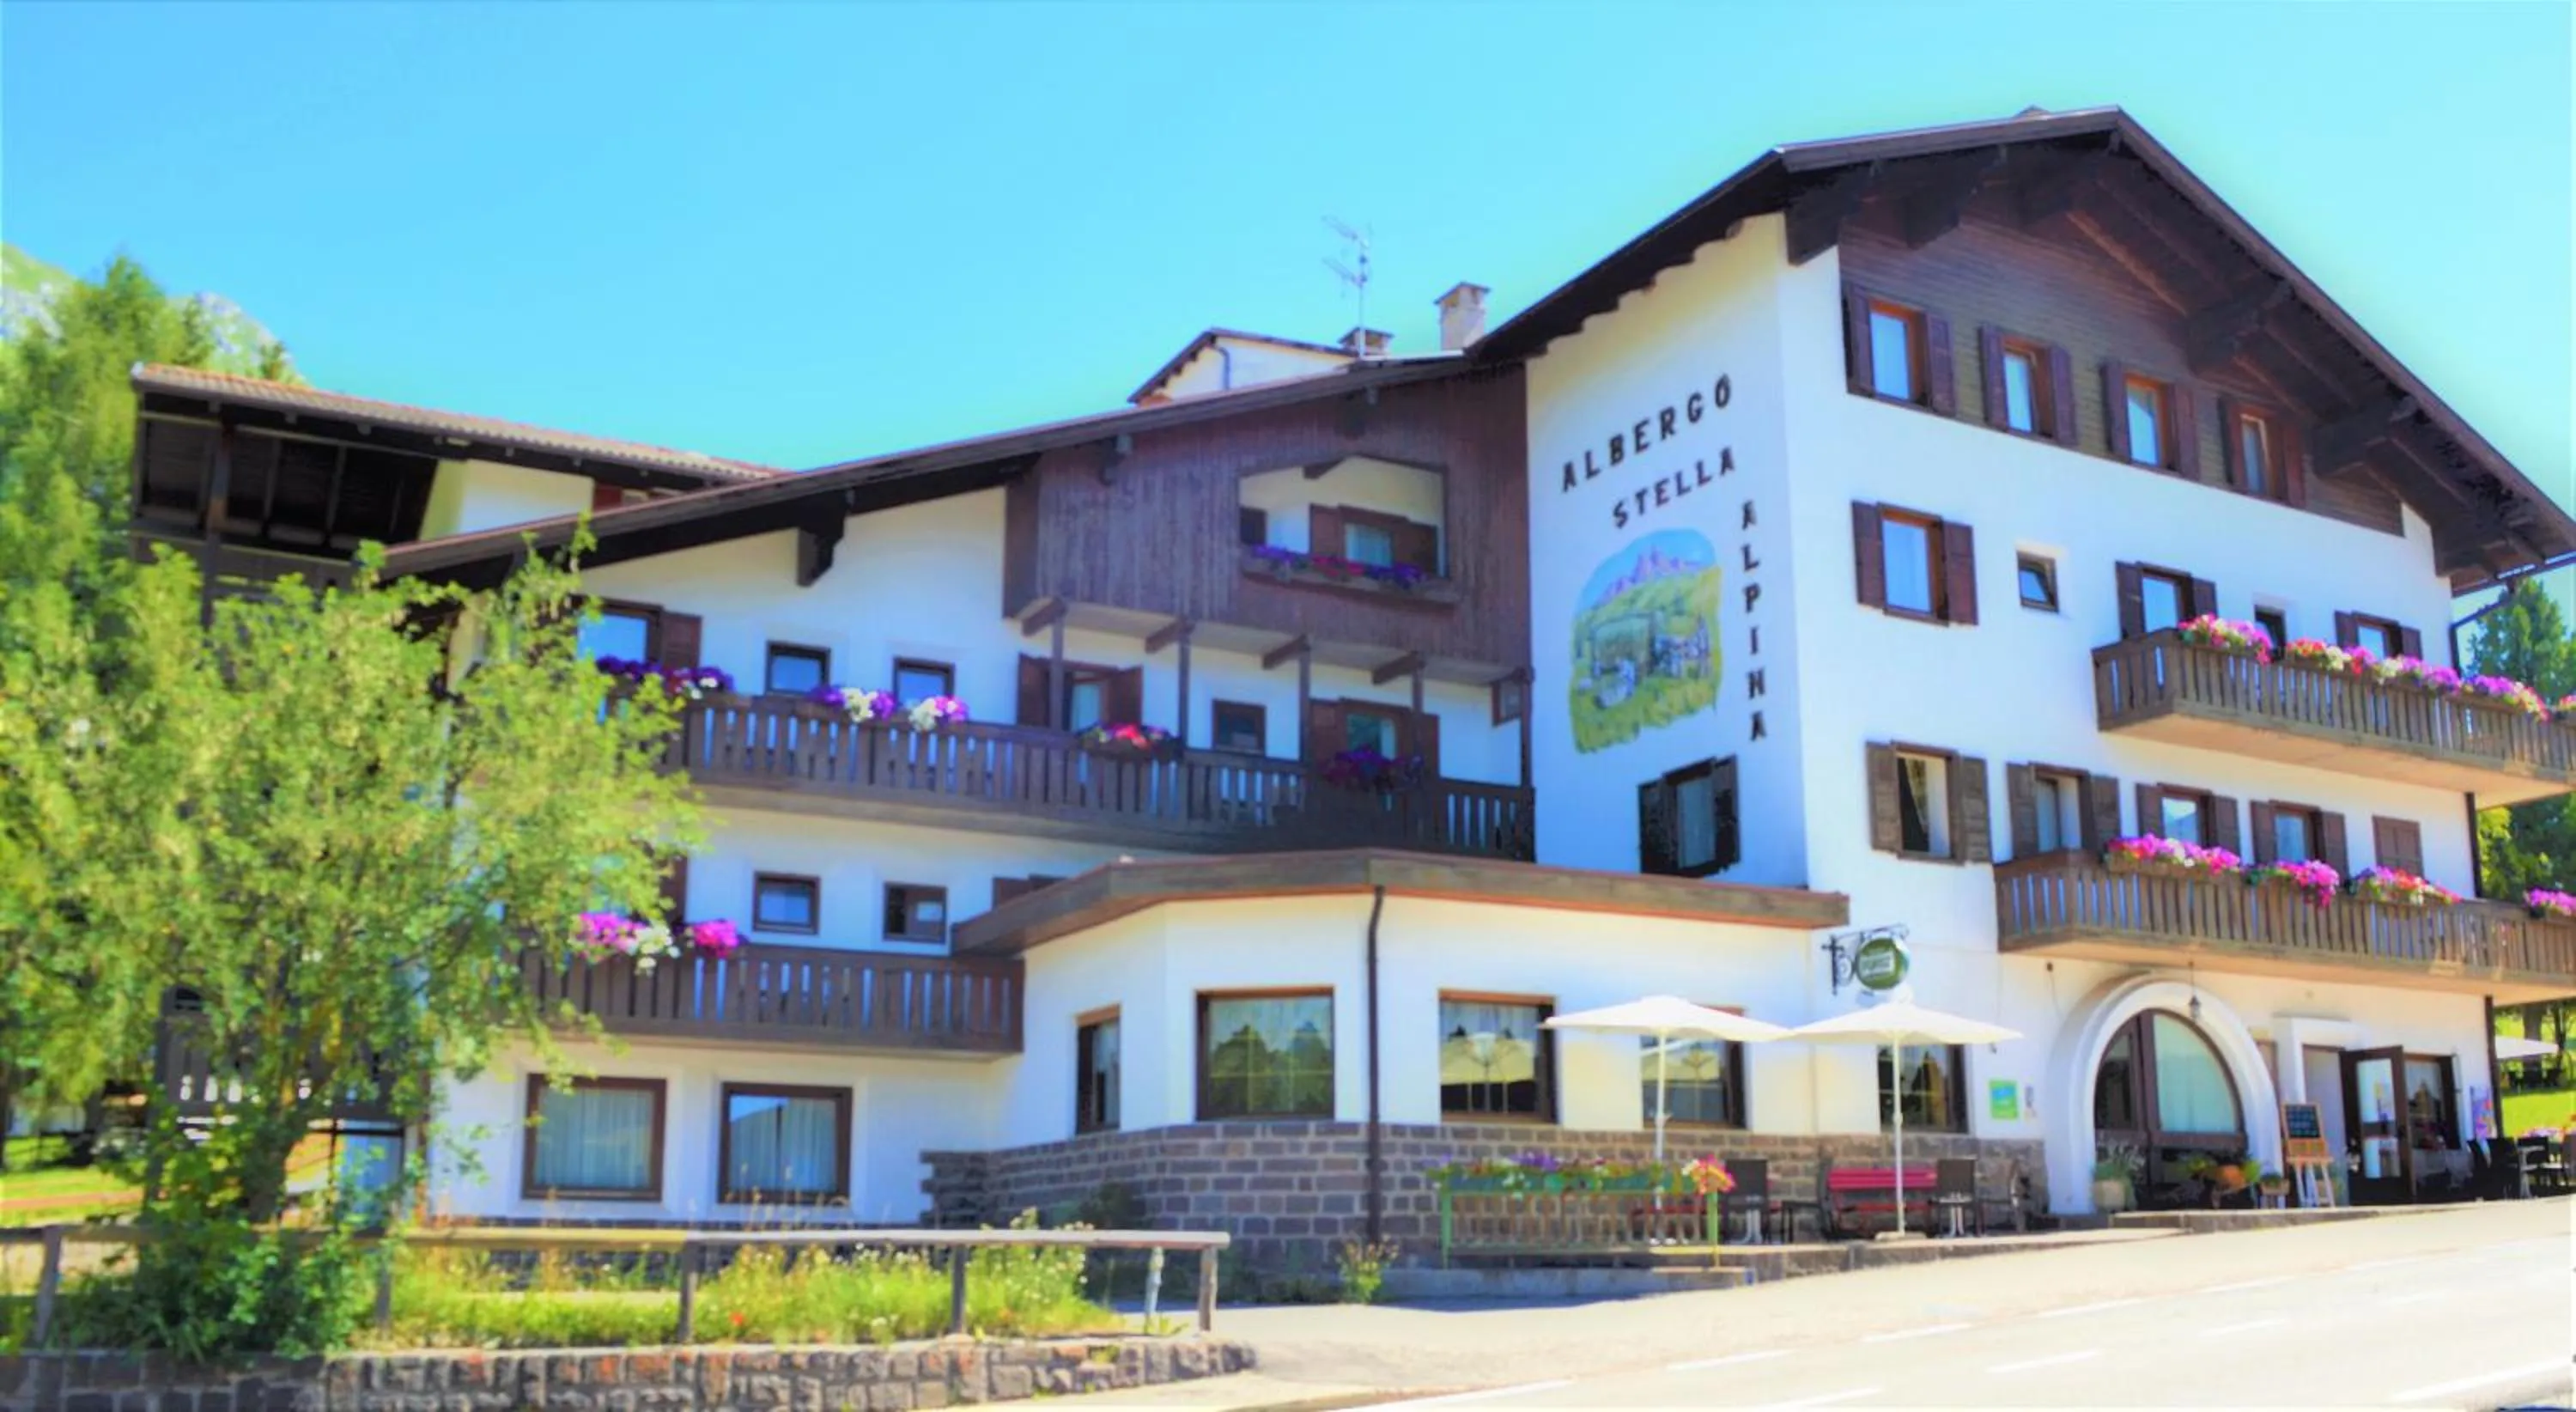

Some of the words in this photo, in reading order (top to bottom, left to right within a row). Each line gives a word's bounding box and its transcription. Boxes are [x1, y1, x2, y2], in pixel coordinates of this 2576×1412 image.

[1562, 373, 1733, 493] ALBERGO
[1613, 447, 1735, 529] STELLA
[1741, 500, 1767, 741] ALPINA
